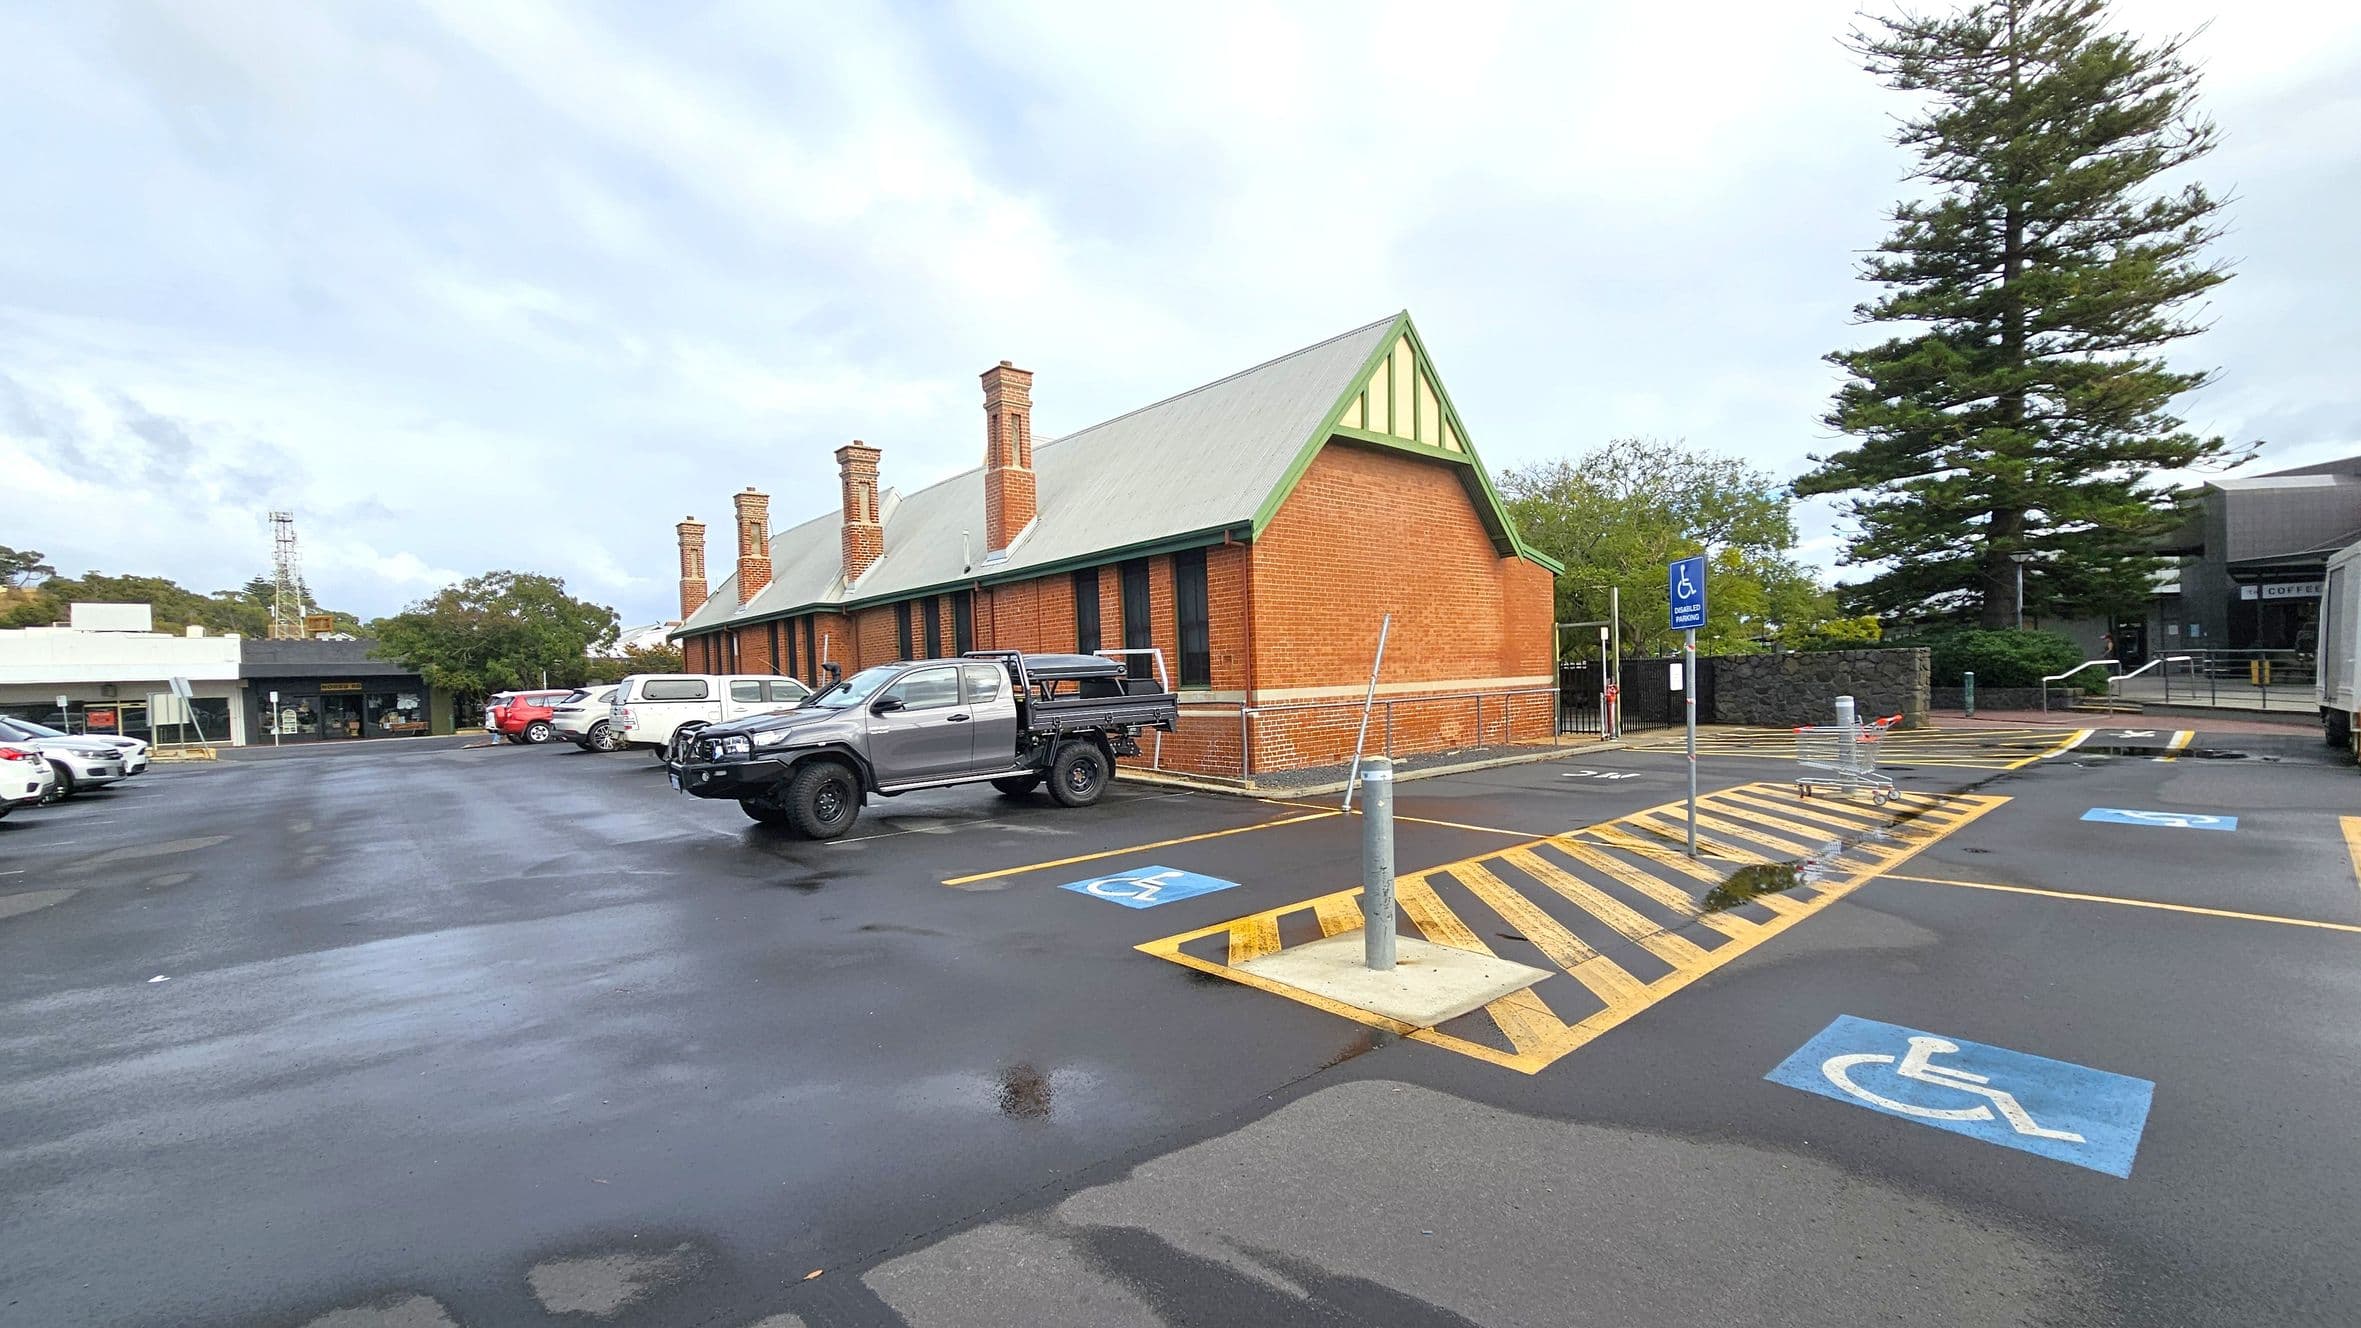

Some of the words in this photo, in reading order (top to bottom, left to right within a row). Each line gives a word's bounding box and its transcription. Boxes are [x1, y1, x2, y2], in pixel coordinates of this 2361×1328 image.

[2269, 585, 2322, 595] COFFEE
[1674, 604, 1701, 614] DISABLED
[1676, 613, 1700, 623] PARKING
